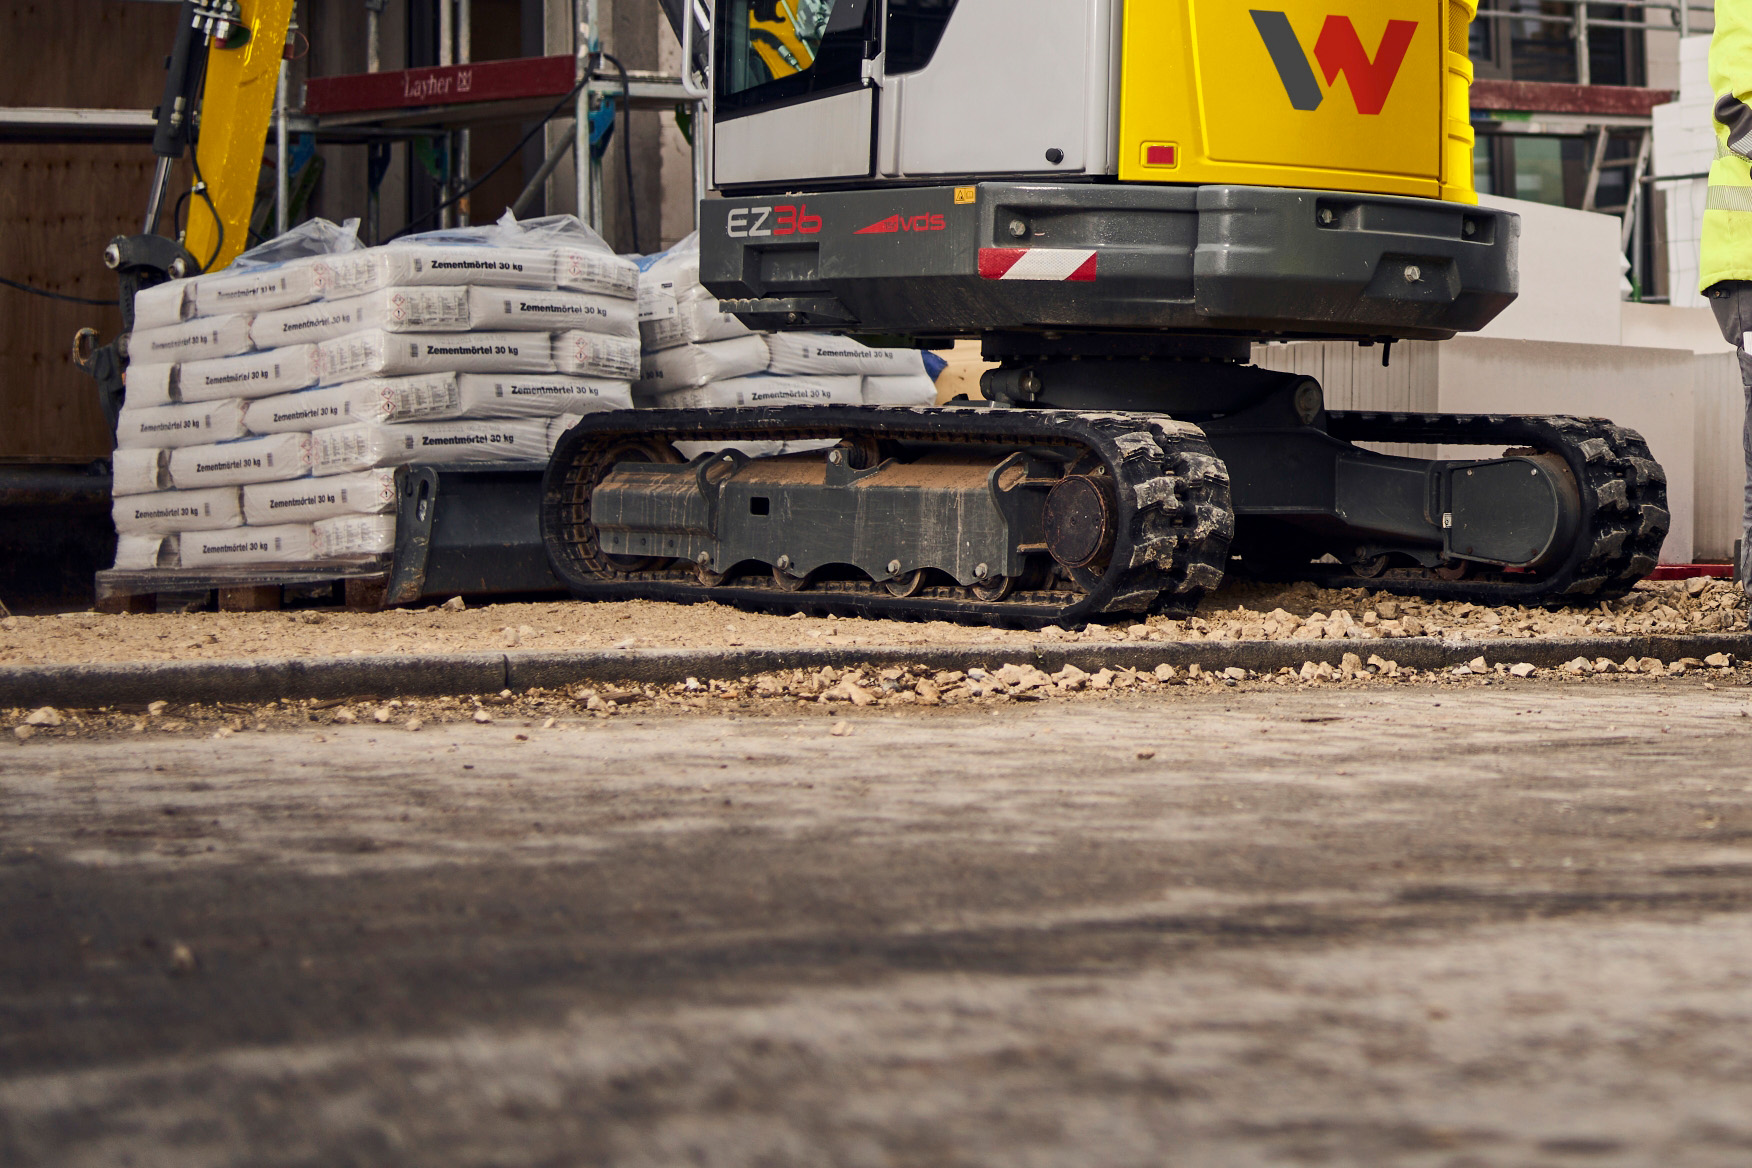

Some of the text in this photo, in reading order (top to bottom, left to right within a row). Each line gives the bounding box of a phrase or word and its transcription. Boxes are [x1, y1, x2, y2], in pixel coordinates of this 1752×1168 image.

[403, 72, 453, 100] Layher
[727, 204, 823, 238] EZ36
[899, 211, 947, 232] vds
[431, 260, 523, 272] Zementmörtel 30 kg
[519, 302, 607, 317] Zementmörtel 30 kg
[427, 345, 518, 356] Zementmörtel 30 kg
[817, 348, 894, 360] Zementmörtel 30 kg
[251, 371, 260, 380] 30
[260, 370, 269, 380] kg
[576, 386, 587, 394] 30
[589, 386, 599, 396] kg
[751, 390, 831, 401] Zementmörtel 30 kg
[273, 406, 338, 423] Zementmörtel 30 kg
[183, 420, 192, 429] 30
[192, 419, 200, 429] kg
[422, 434, 514, 446] Zementmörtel 30 kg
[196, 457, 261, 473] Zementmörtel 30 kg
[270, 493, 335, 509] Zementmörtel 30 kg
[135, 506, 199, 519] Zementmörtel 30 kg
[203, 541, 268, 554] Zementmörtel 30 kg
